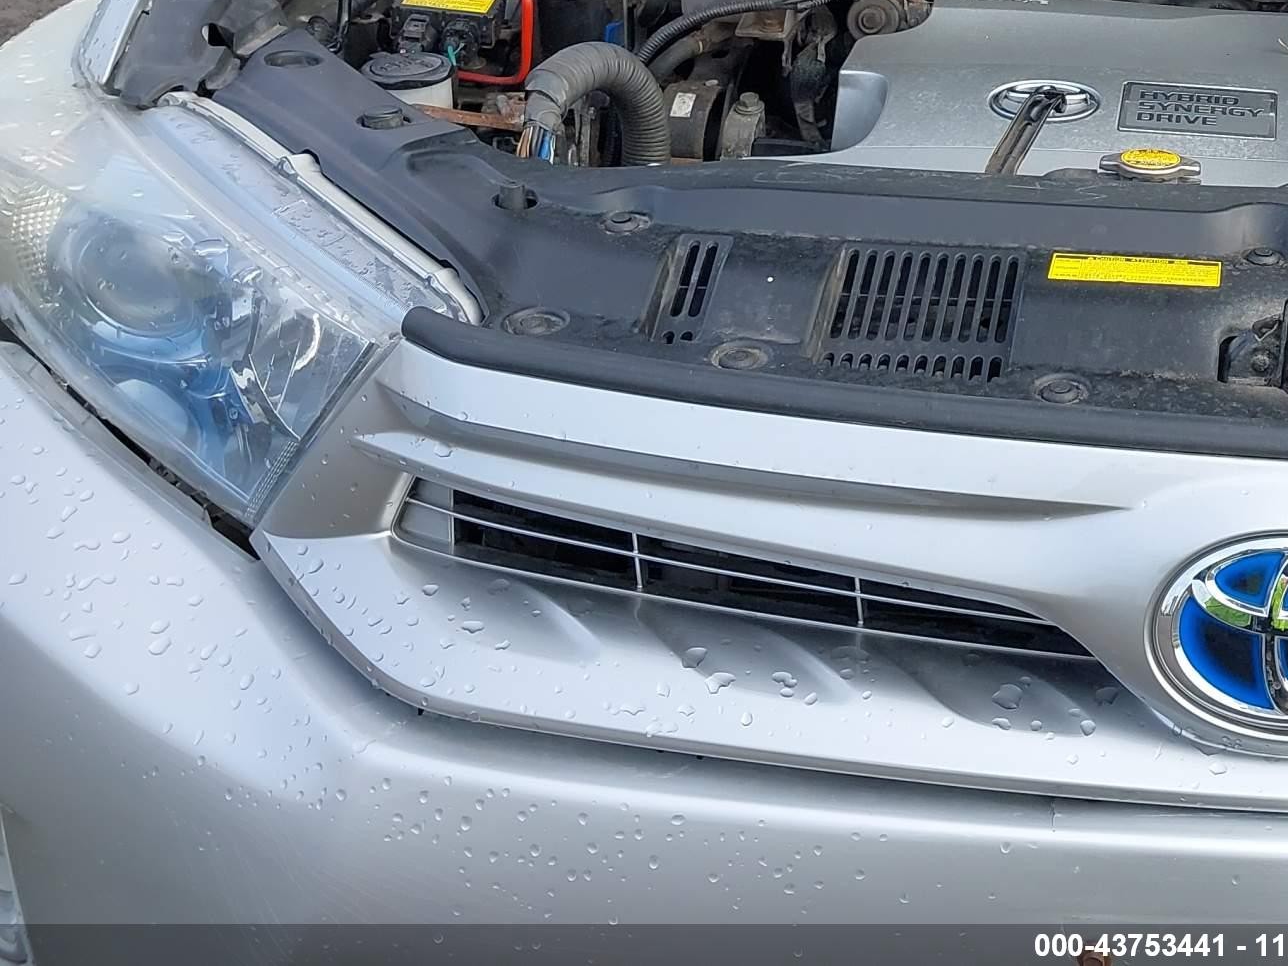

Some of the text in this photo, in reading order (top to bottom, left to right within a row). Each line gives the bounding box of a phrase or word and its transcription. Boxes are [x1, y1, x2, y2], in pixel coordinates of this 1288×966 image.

[1139, 89, 1240, 106] HYBRID
[1138, 100, 1264, 118] SYNERGY
[1136, 111, 1217, 126] DRIVE
